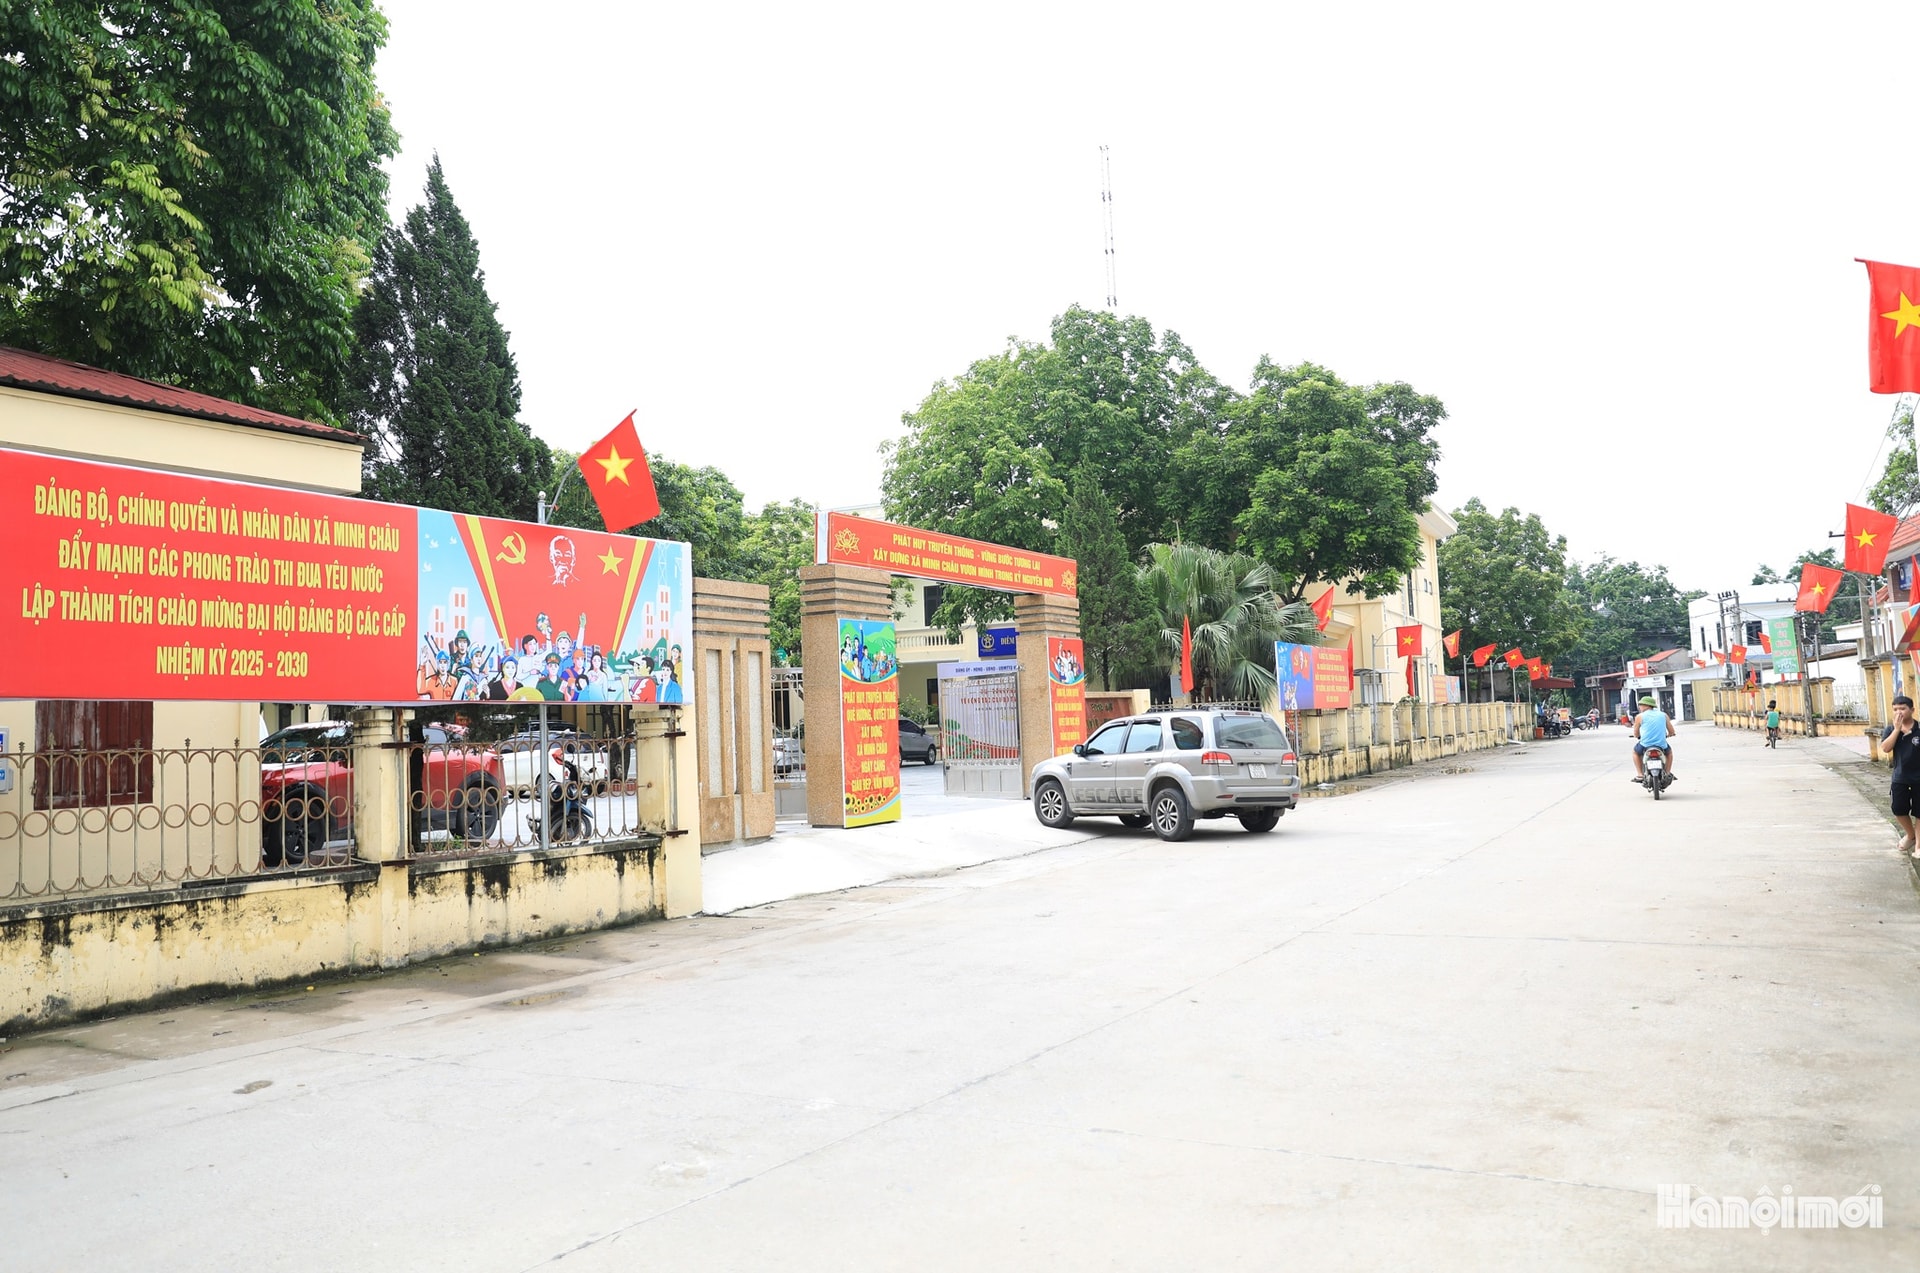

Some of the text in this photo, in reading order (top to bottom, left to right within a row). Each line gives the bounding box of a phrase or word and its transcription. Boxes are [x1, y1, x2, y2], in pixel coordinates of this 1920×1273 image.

[35, 477, 400, 552] ĐẢNG BỘ, CHÍNH QUYỀN VÀ NHÂN DÂN XÃ MINH CHÂU
[58, 528, 383, 593] ĐẨY MẠNH CÁC PHONG TRÀO THI ĐUA YÊU NƯỚC
[873, 547, 888, 562] XÂY
[890, 551, 910, 566] DỰNG
[922, 557, 941, 570] MINH
[893, 533, 911, 546] PHÁT
[913, 537, 926, 549] HUY
[22, 582, 406, 640] LẬP THÀNH TÍCH CHÀO MỪNG ĐẠI HỘI ĐẢNG BỘ CÁC CẤP
[156, 641, 204, 681] NHIỆM
[209, 643, 227, 676] KỲ
[230, 649, 264, 677] 2025
[276, 650, 308, 678] 2030
[1071, 788, 1143, 803] ESCAPE
